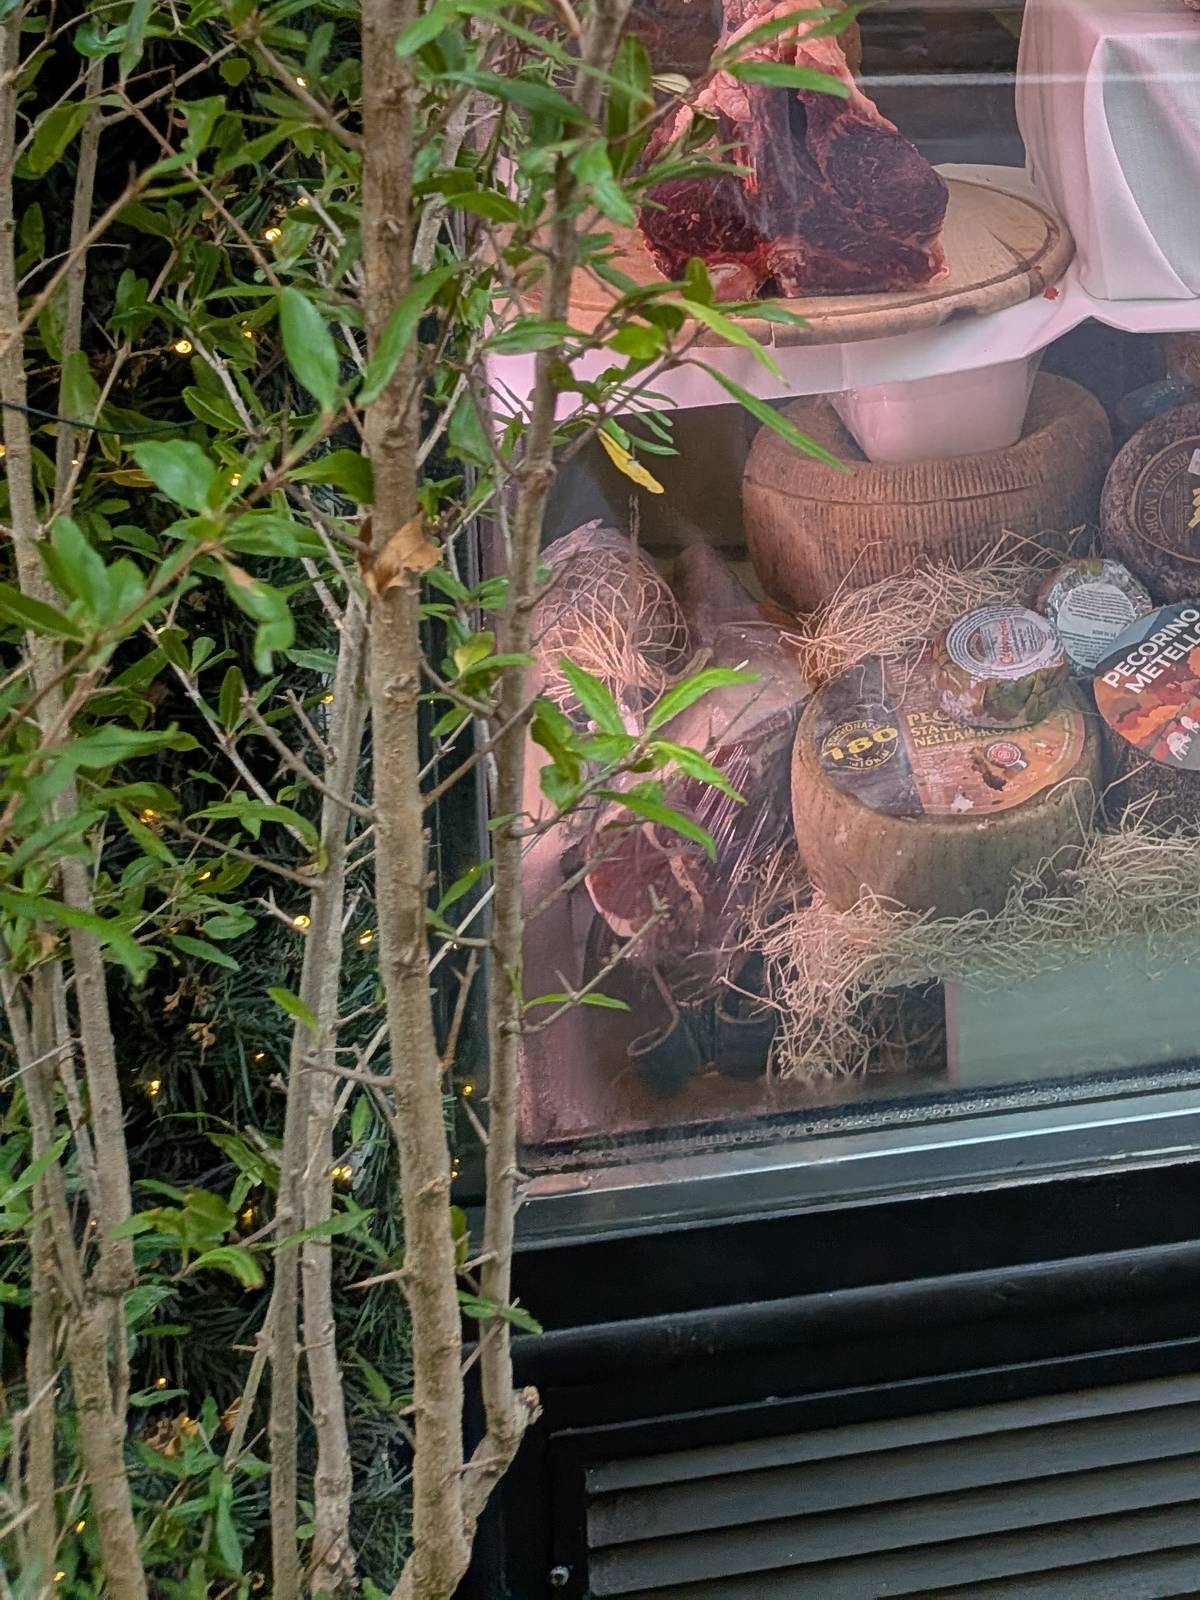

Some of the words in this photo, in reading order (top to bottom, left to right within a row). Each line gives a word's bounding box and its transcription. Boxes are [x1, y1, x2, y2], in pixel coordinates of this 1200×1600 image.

[1101, 608, 1200, 689] PECORINO
[822, 726, 898, 761] 180
[914, 731, 965, 748] NELLA
